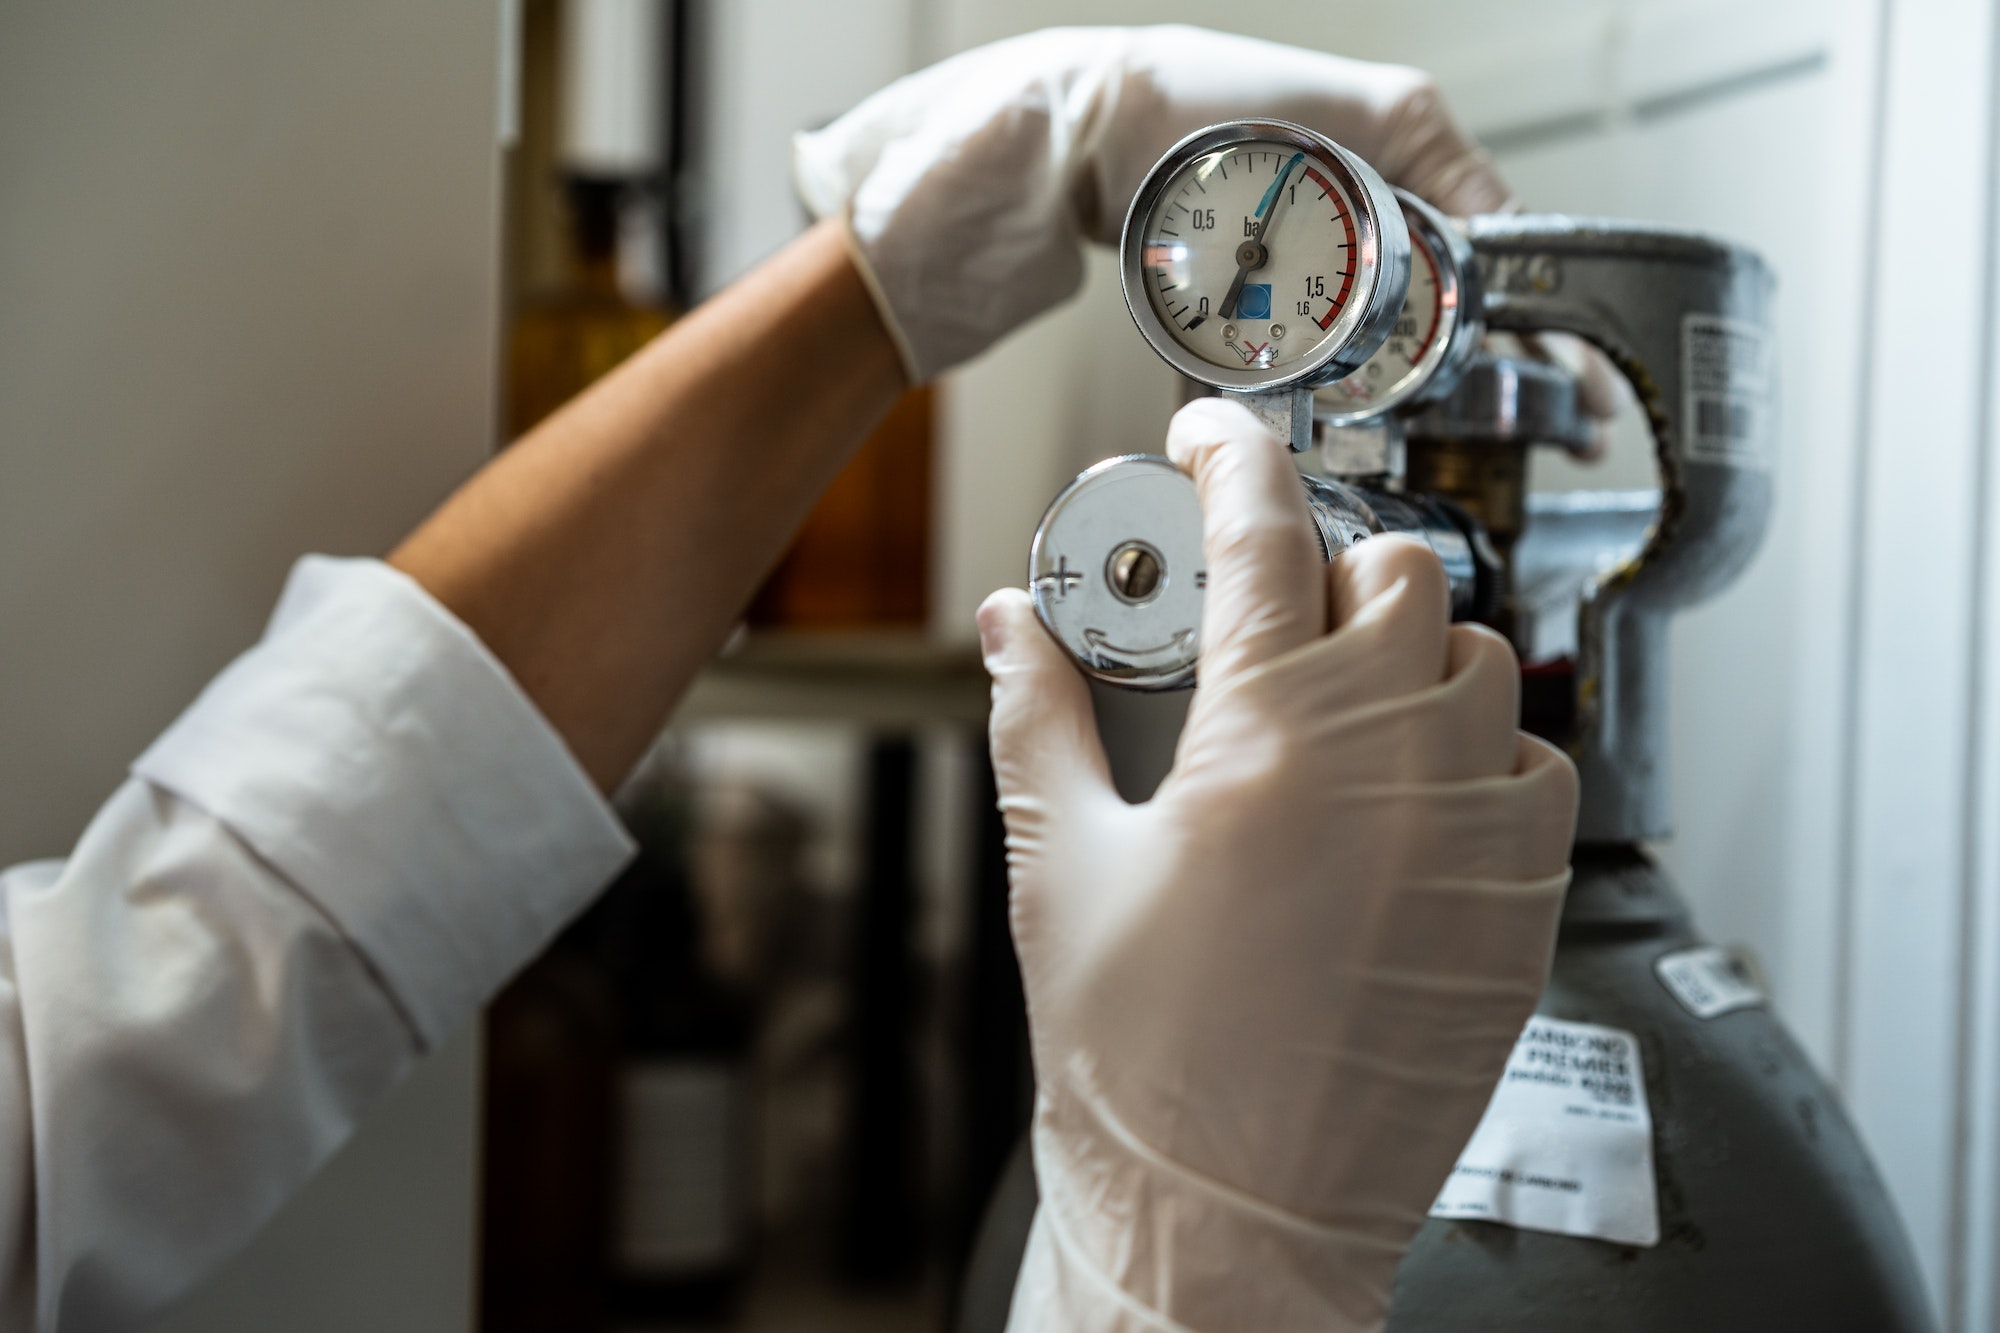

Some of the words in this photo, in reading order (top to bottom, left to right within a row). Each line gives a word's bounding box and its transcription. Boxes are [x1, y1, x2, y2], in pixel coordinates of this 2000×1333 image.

[1289, 184, 1296, 205] 1
[1193, 209, 1215, 230] 0,5
[1244, 216, 1261, 237] ba
[1305, 276, 1324, 299] 1,5
[1200, 297, 1209, 315] 0
[1296, 301, 1310, 317] 1,6
[1525, 1028, 1632, 1057] ARBONO
[1528, 1049, 1632, 1076] PREMIER
